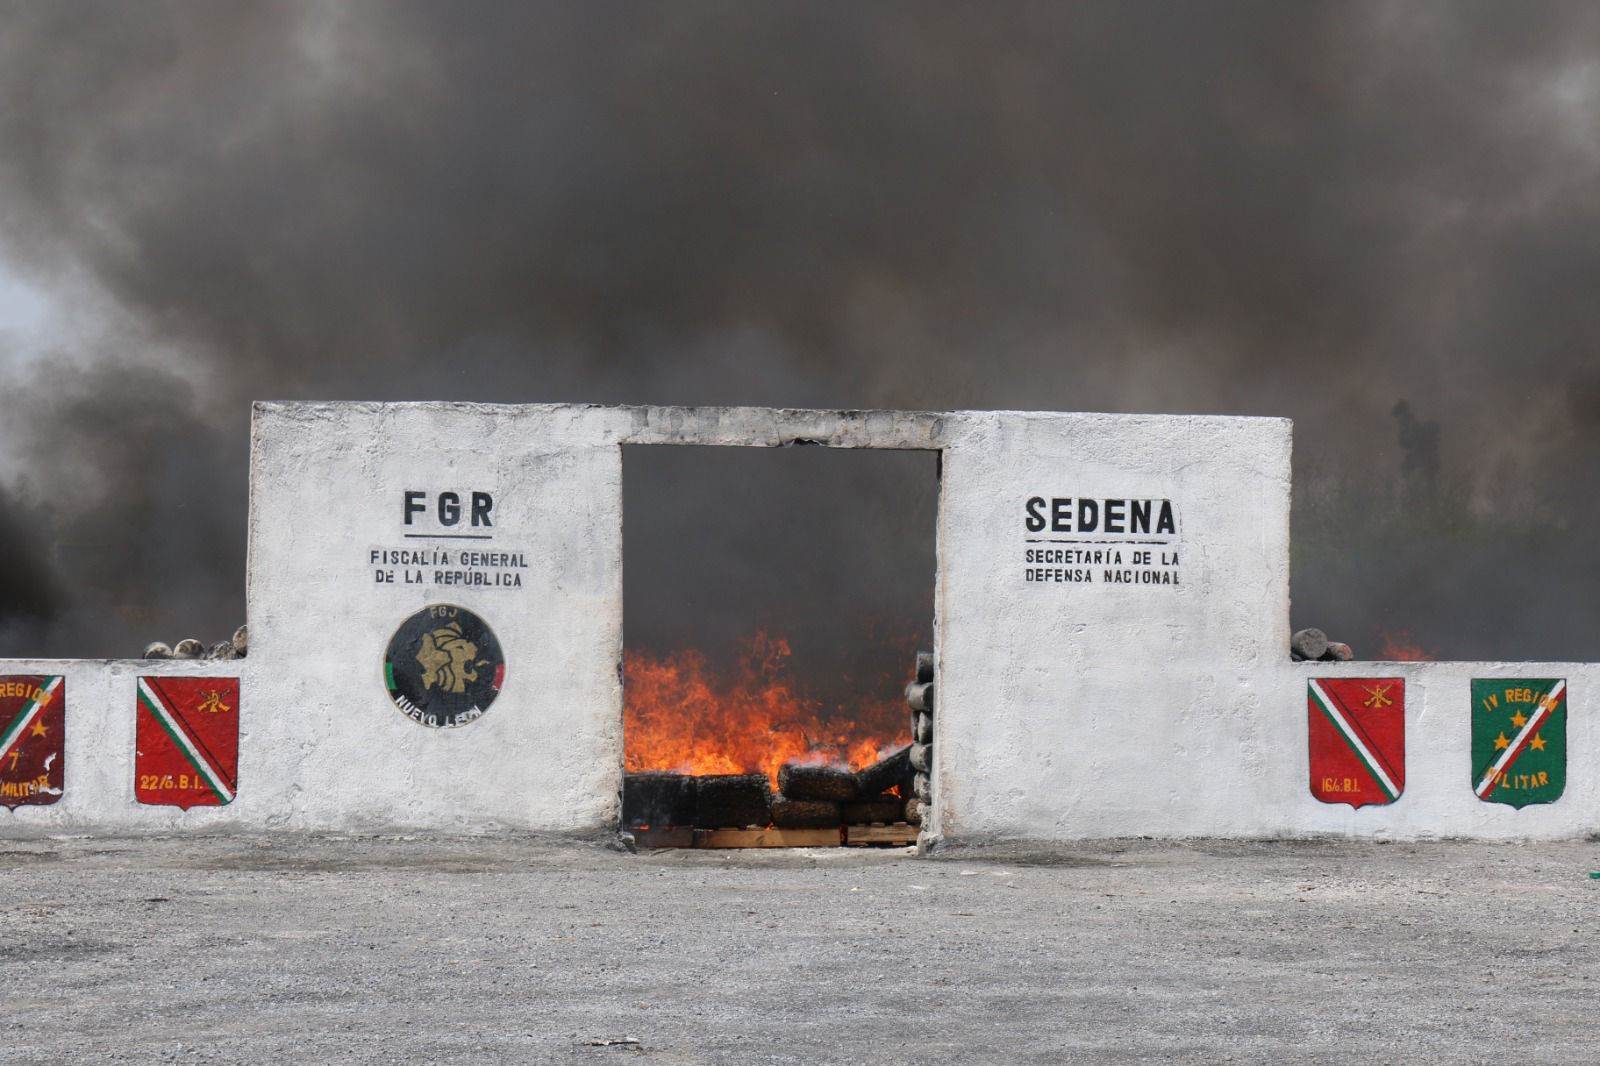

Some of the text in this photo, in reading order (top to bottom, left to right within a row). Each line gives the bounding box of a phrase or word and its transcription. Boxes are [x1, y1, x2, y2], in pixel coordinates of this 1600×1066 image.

[404, 491, 493, 526] FGR
[1026, 496, 1175, 534] SEDENA
[371, 546, 528, 568] FISCALÍA GENERAL
[1025, 548, 1179, 566] SECRETARÍA DE LA
[375, 567, 521, 587] DE LA REPÚBLICA
[1026, 568, 1180, 584] DEFENSA NACIONAL
[429, 606, 458, 619] FGJ
